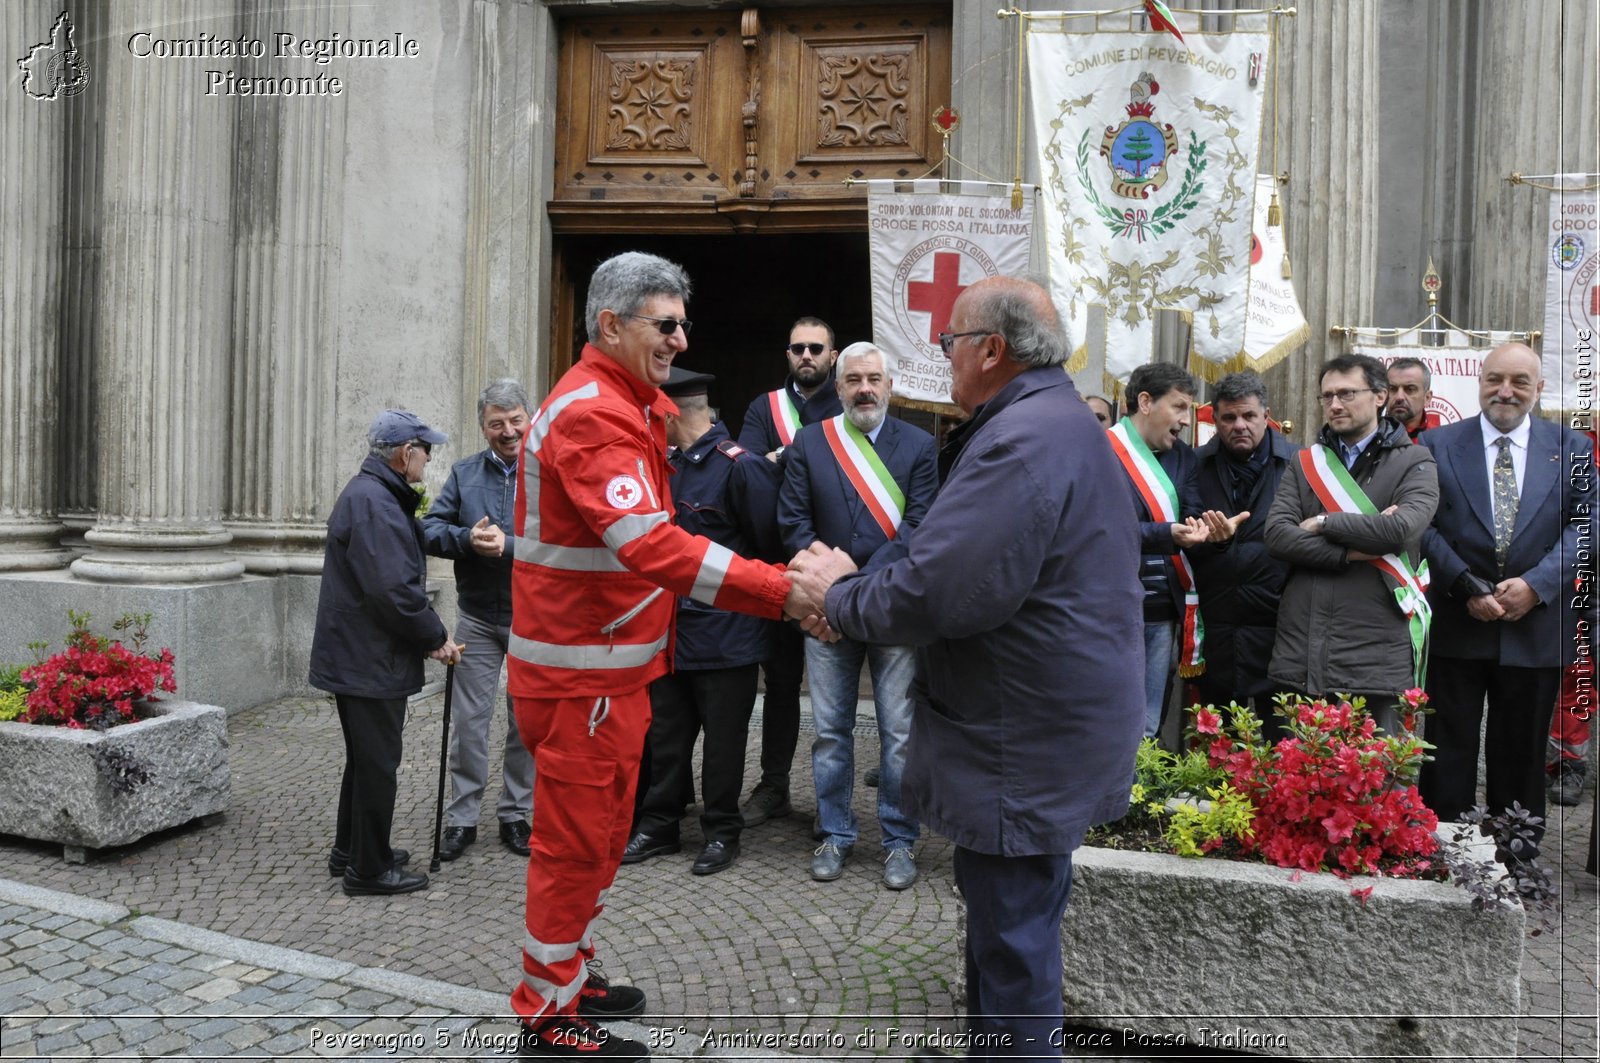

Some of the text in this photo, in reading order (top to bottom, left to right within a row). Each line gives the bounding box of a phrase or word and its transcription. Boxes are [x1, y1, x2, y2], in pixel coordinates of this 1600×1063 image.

[1065, 47, 1238, 80] COMUNE DI PEVERAGNO
[878, 204, 1022, 220] CORPO VOLONTARI DEL SOCCORSO
[1560, 204, 1595, 215] CORPO
[871, 217, 1029, 236] CROCE ROSSA ITALIANA
[896, 238, 951, 282] CONVENZIONE
[955, 238, 967, 249] DI
[900, 373, 953, 395] PEVERA
